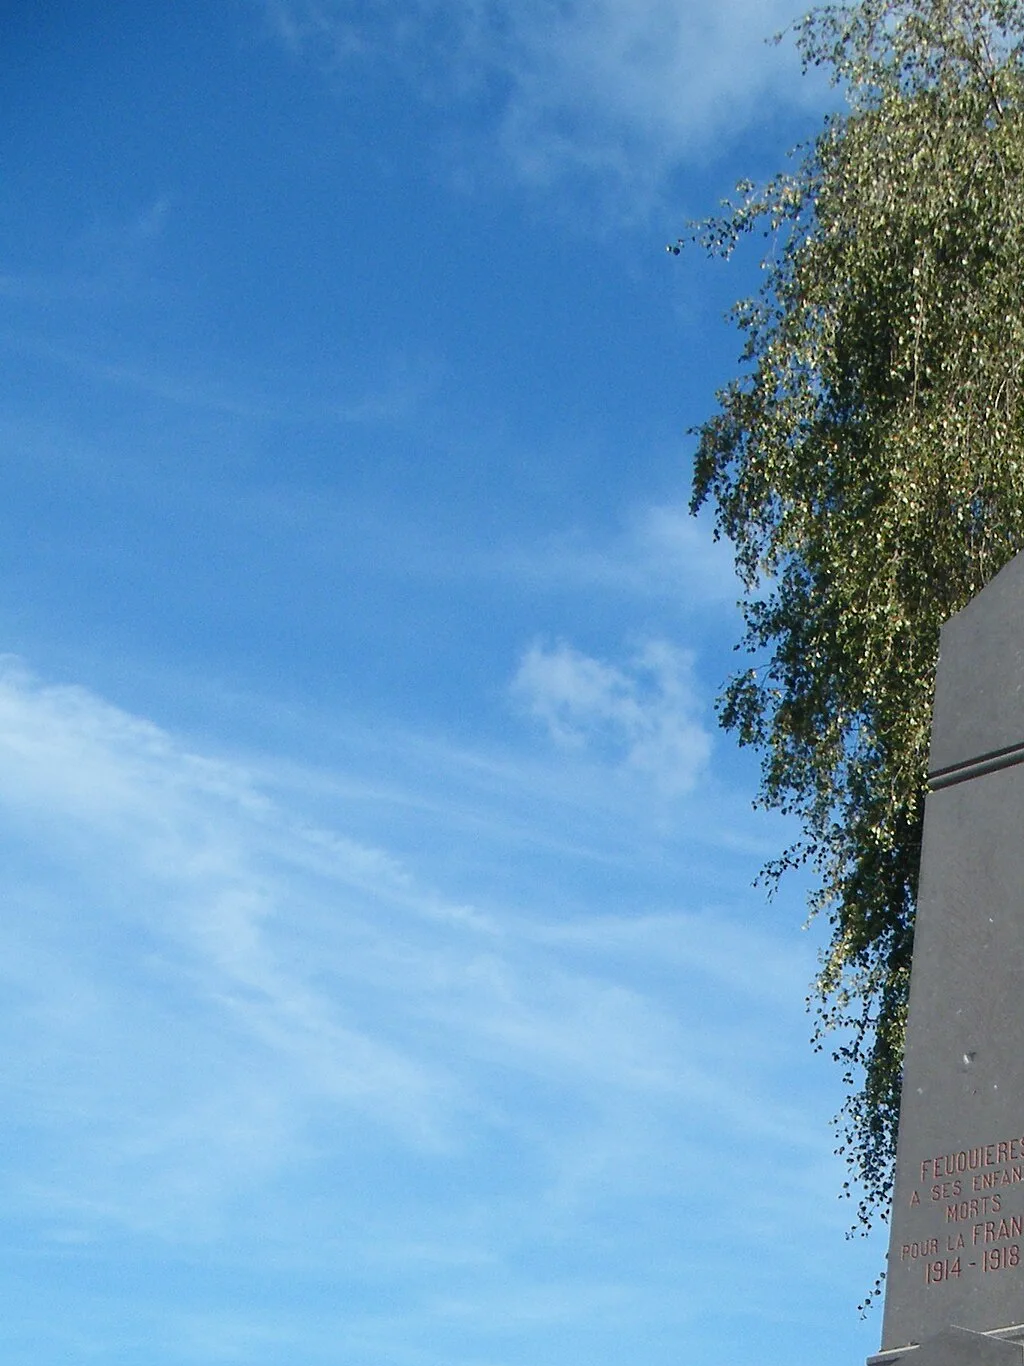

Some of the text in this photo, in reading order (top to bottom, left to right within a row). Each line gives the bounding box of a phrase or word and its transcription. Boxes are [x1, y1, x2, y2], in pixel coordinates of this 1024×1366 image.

[931, 1180, 962, 1202] SES
[946, 1194, 1002, 1223] MORTS
[901, 1238, 938, 1261] POUR
[947, 1234, 965, 1251] LA
[925, 1256, 962, 1285] 1914
[982, 1245, 1020, 1273] 1918
